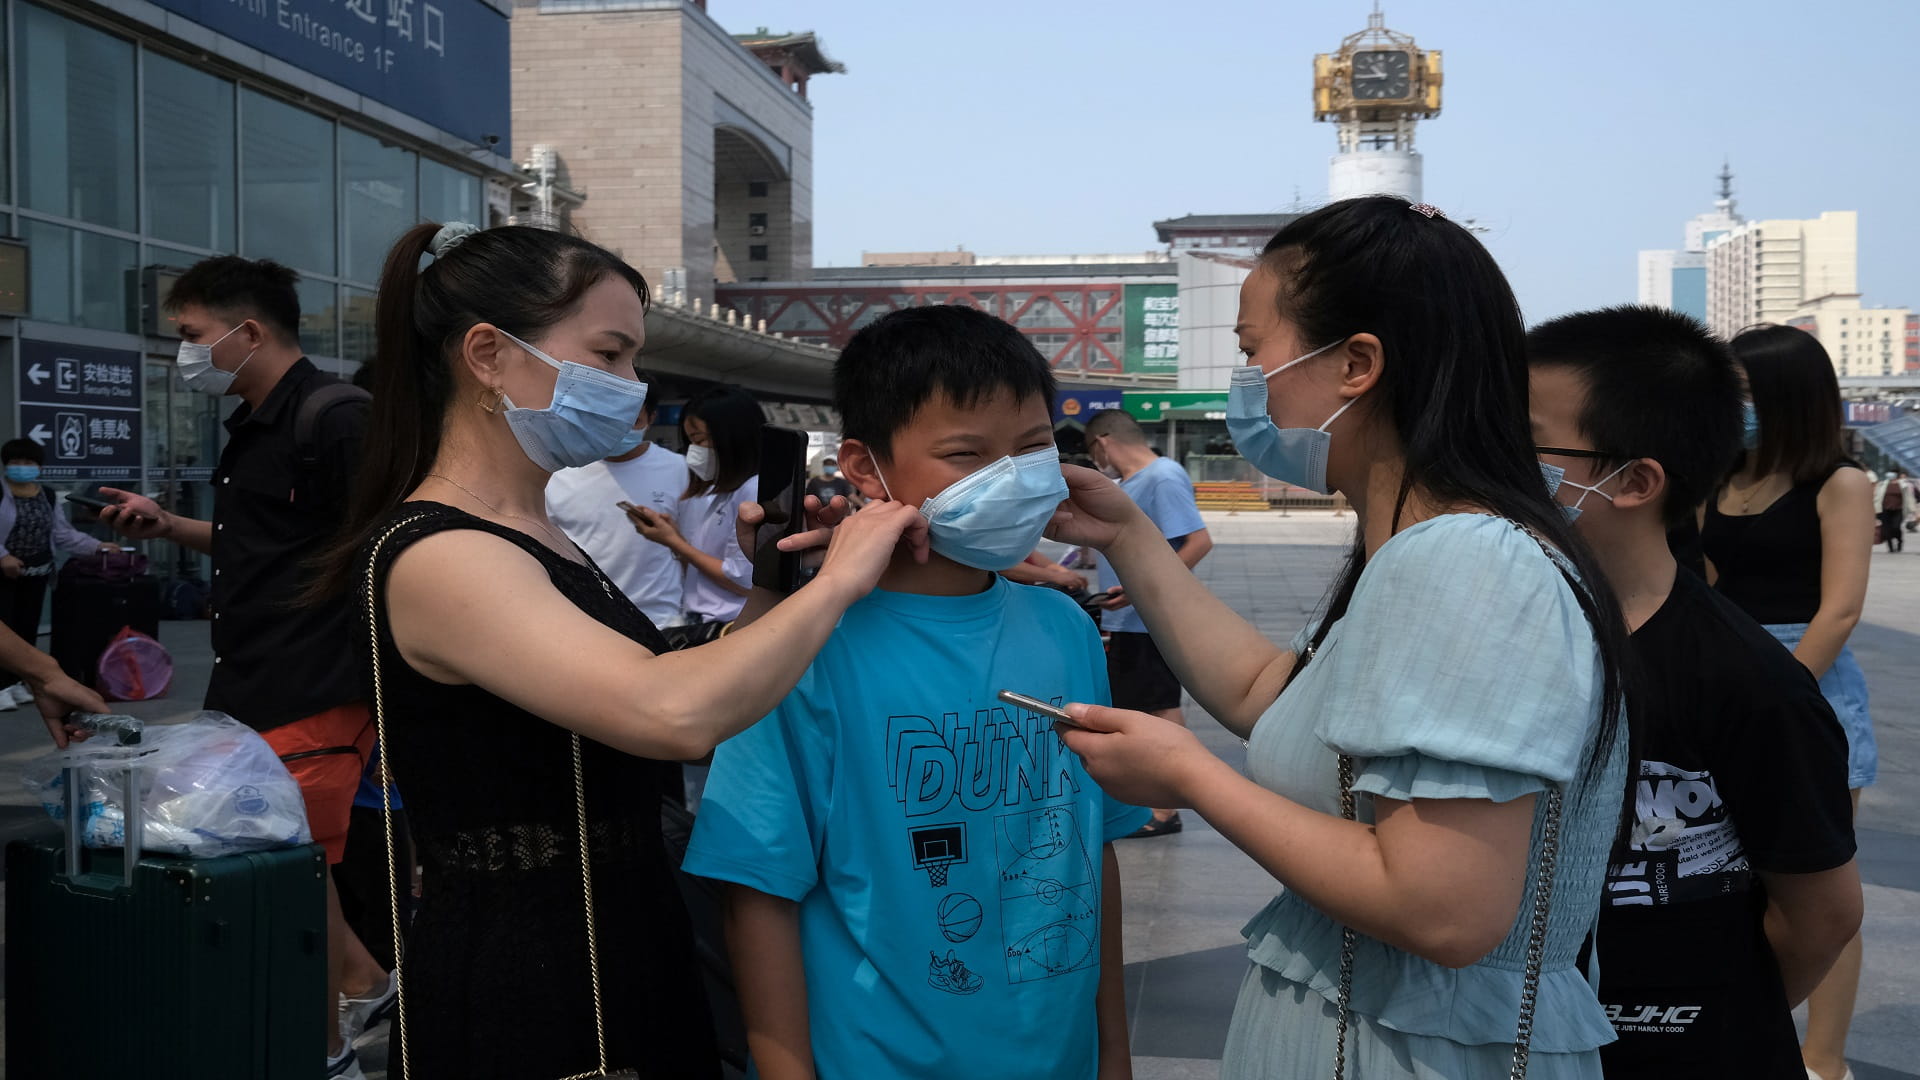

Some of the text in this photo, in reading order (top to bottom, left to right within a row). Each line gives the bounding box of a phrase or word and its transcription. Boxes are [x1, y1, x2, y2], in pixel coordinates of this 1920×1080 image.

[277, 0, 395, 73] Entrance 1F
[83, 363, 133, 385] 安检进站
[89, 418, 131, 441] 售票处
[904, 728, 1081, 818] DUNK
